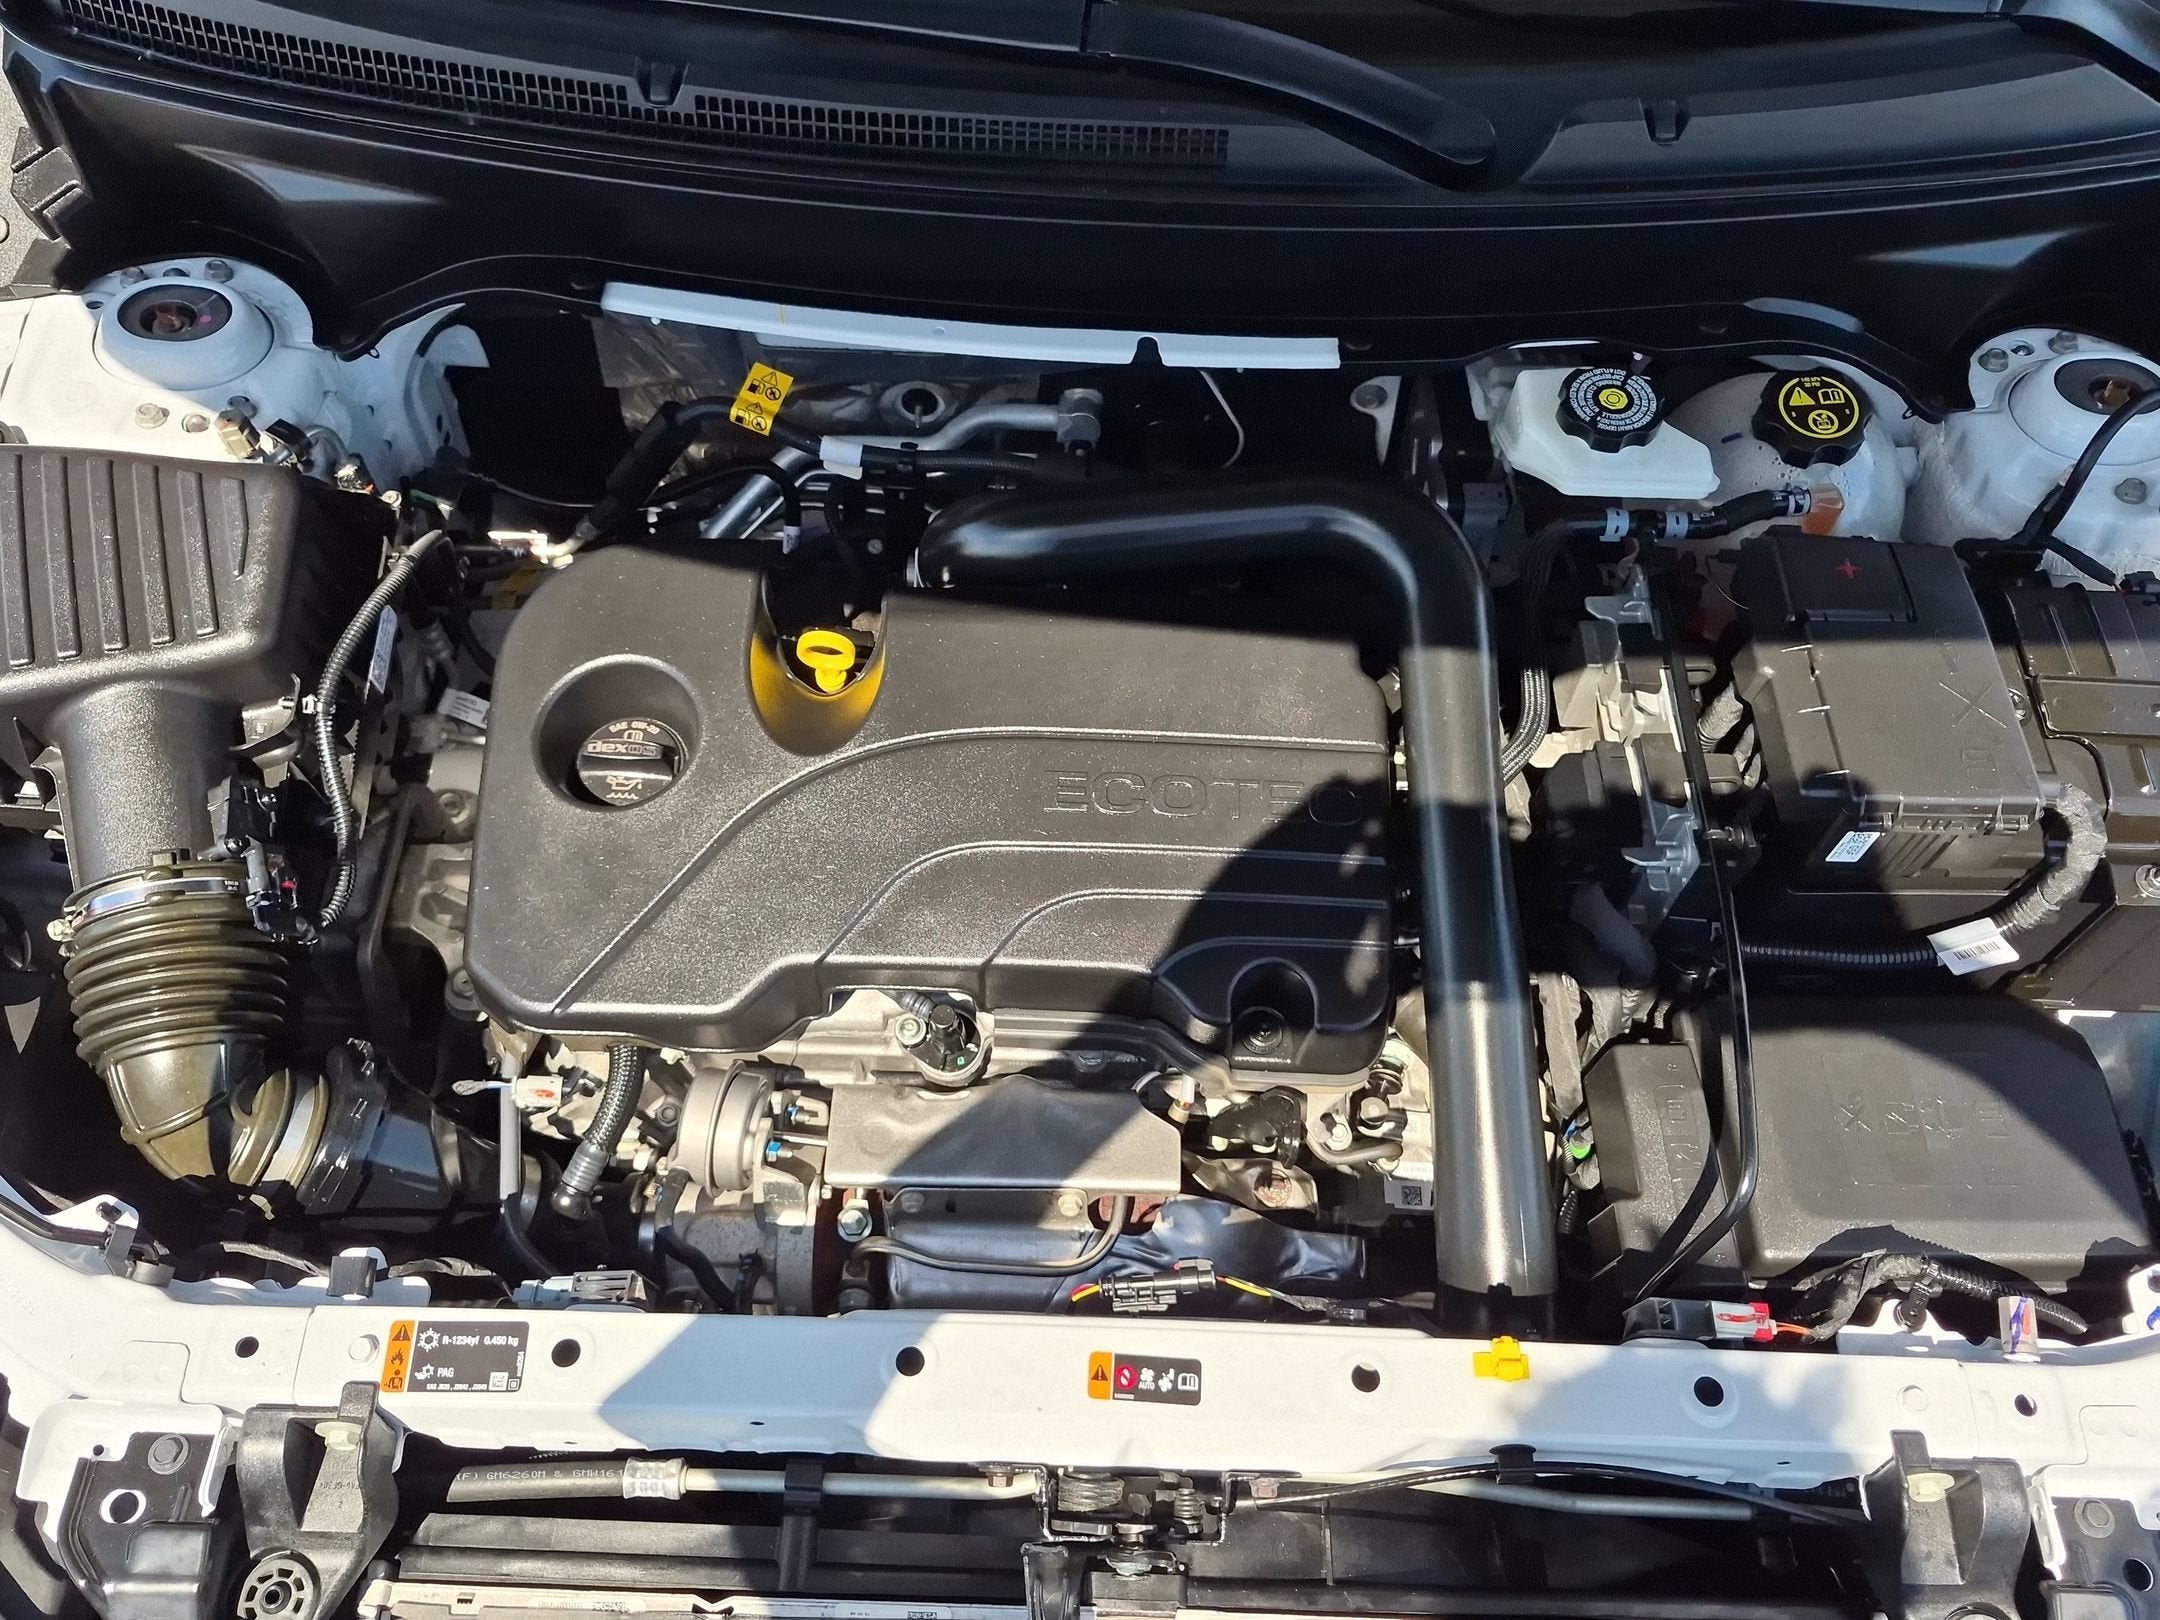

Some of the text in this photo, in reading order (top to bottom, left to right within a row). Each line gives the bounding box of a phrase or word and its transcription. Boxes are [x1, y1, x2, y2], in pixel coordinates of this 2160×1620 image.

[1578, 371, 1594, 381] FROM
[608, 721, 628, 732] SAE
[587, 741, 656, 756] dexos
[1043, 770, 1361, 826] ECOTEC
[484, 1336, 506, 1345] 0.450
[508, 1335, 519, 1347] kg
[437, 1367, 455, 1378] PAG
[1138, 1382, 1155, 1390] AUTO
[486, 1470, 546, 1480] GM6260M
[554, 1470, 563, 1478] &
